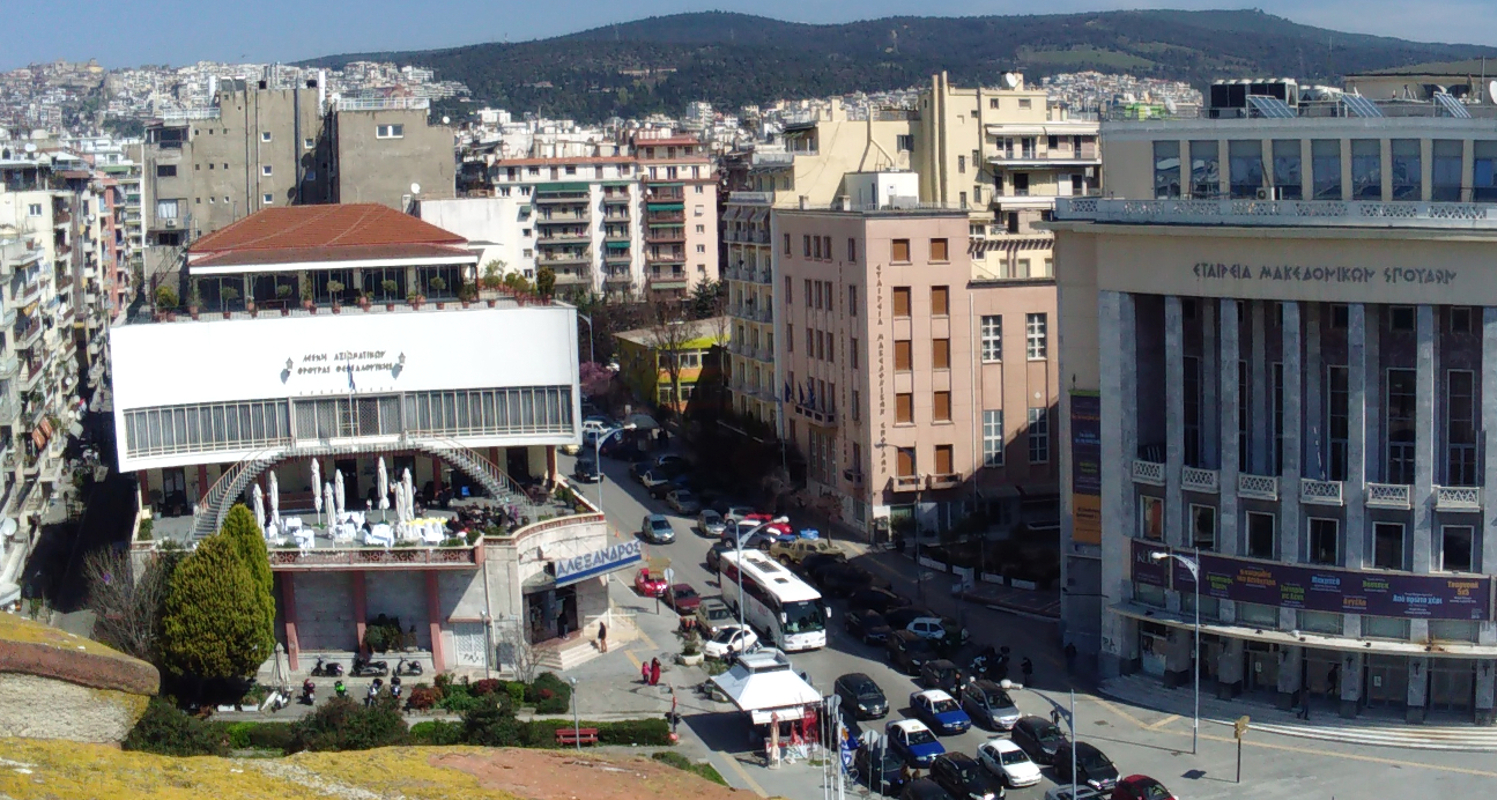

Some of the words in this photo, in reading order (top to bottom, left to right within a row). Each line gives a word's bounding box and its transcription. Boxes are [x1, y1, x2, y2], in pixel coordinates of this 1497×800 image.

[1193, 263, 1252, 279] ΕΤΑΙΡΕΙΑ
[1259, 265, 1376, 283] ΜΑΚΕΔΟΝΙΚΩΝ
[1384, 267, 1457, 284] ΣΠΟΥΔΩΝ
[336, 362, 393, 373] ΘΕΣΑΛΟΝΙΚΗΣ
